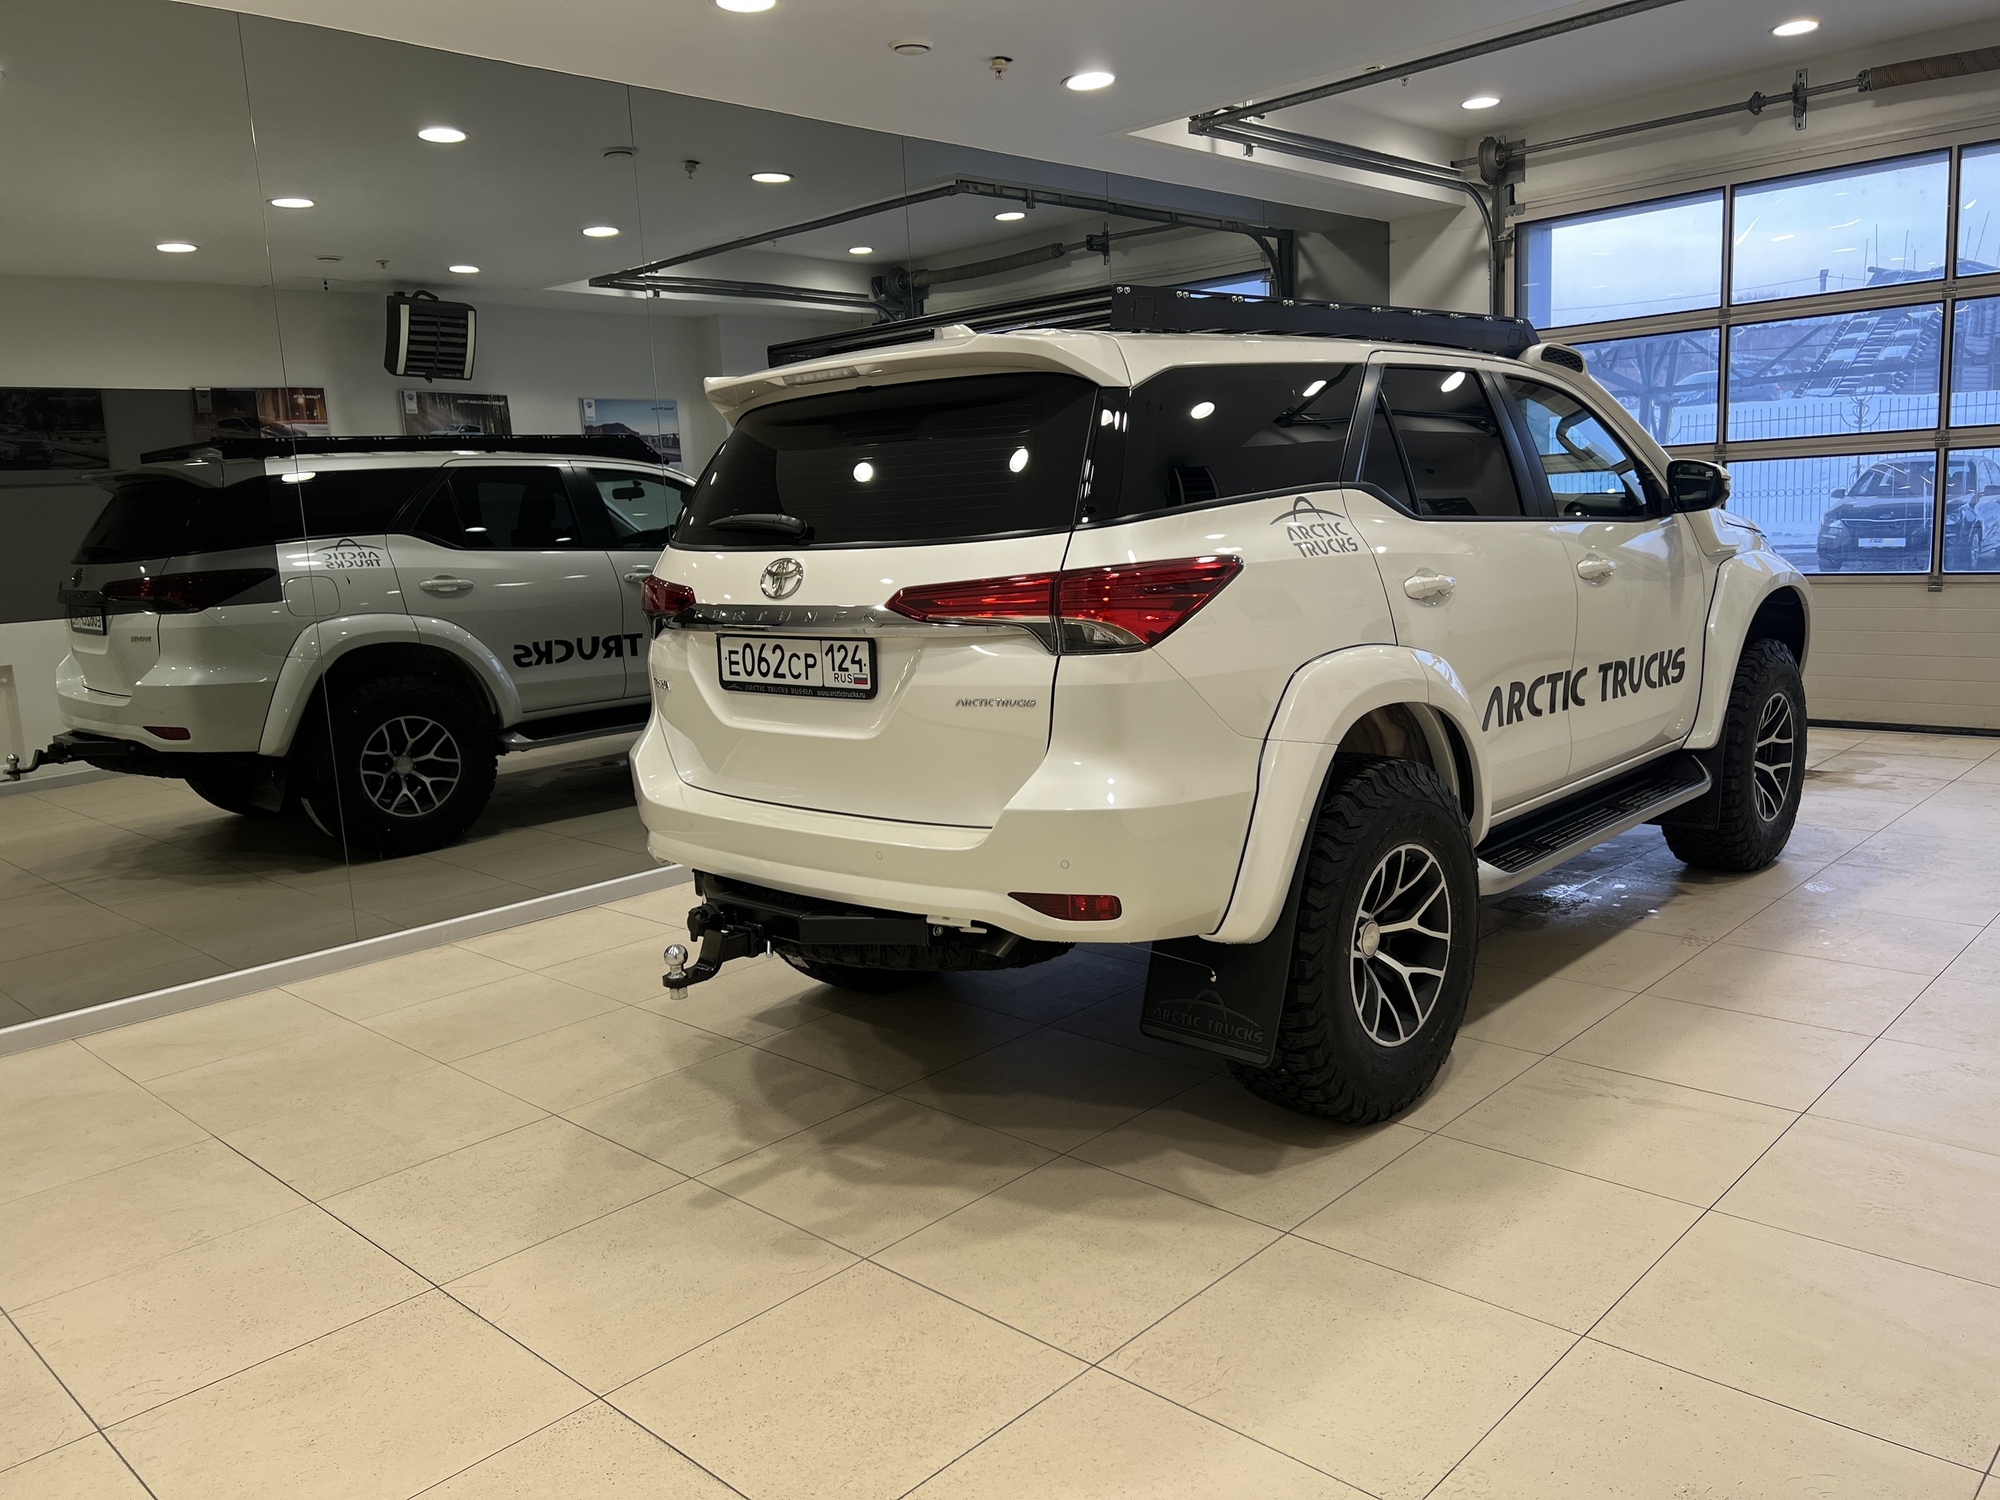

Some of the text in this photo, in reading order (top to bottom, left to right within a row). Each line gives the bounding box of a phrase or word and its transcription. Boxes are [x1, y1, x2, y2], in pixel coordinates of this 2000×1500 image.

[1288, 520, 1349, 542] ARCTIC
[1293, 536, 1359, 558] TRUCKS
[824, 644, 863, 673] 124
[834, 673, 853, 684] RUS
[1481, 646, 1686, 732] ARCTIC TRUCKS
[744, 684, 866, 699] ARCTIC TRUCKS RUSSIA www.arctictrucks.ru
[1153, 1006, 1264, 1044] ARCTIC TRUCKS
